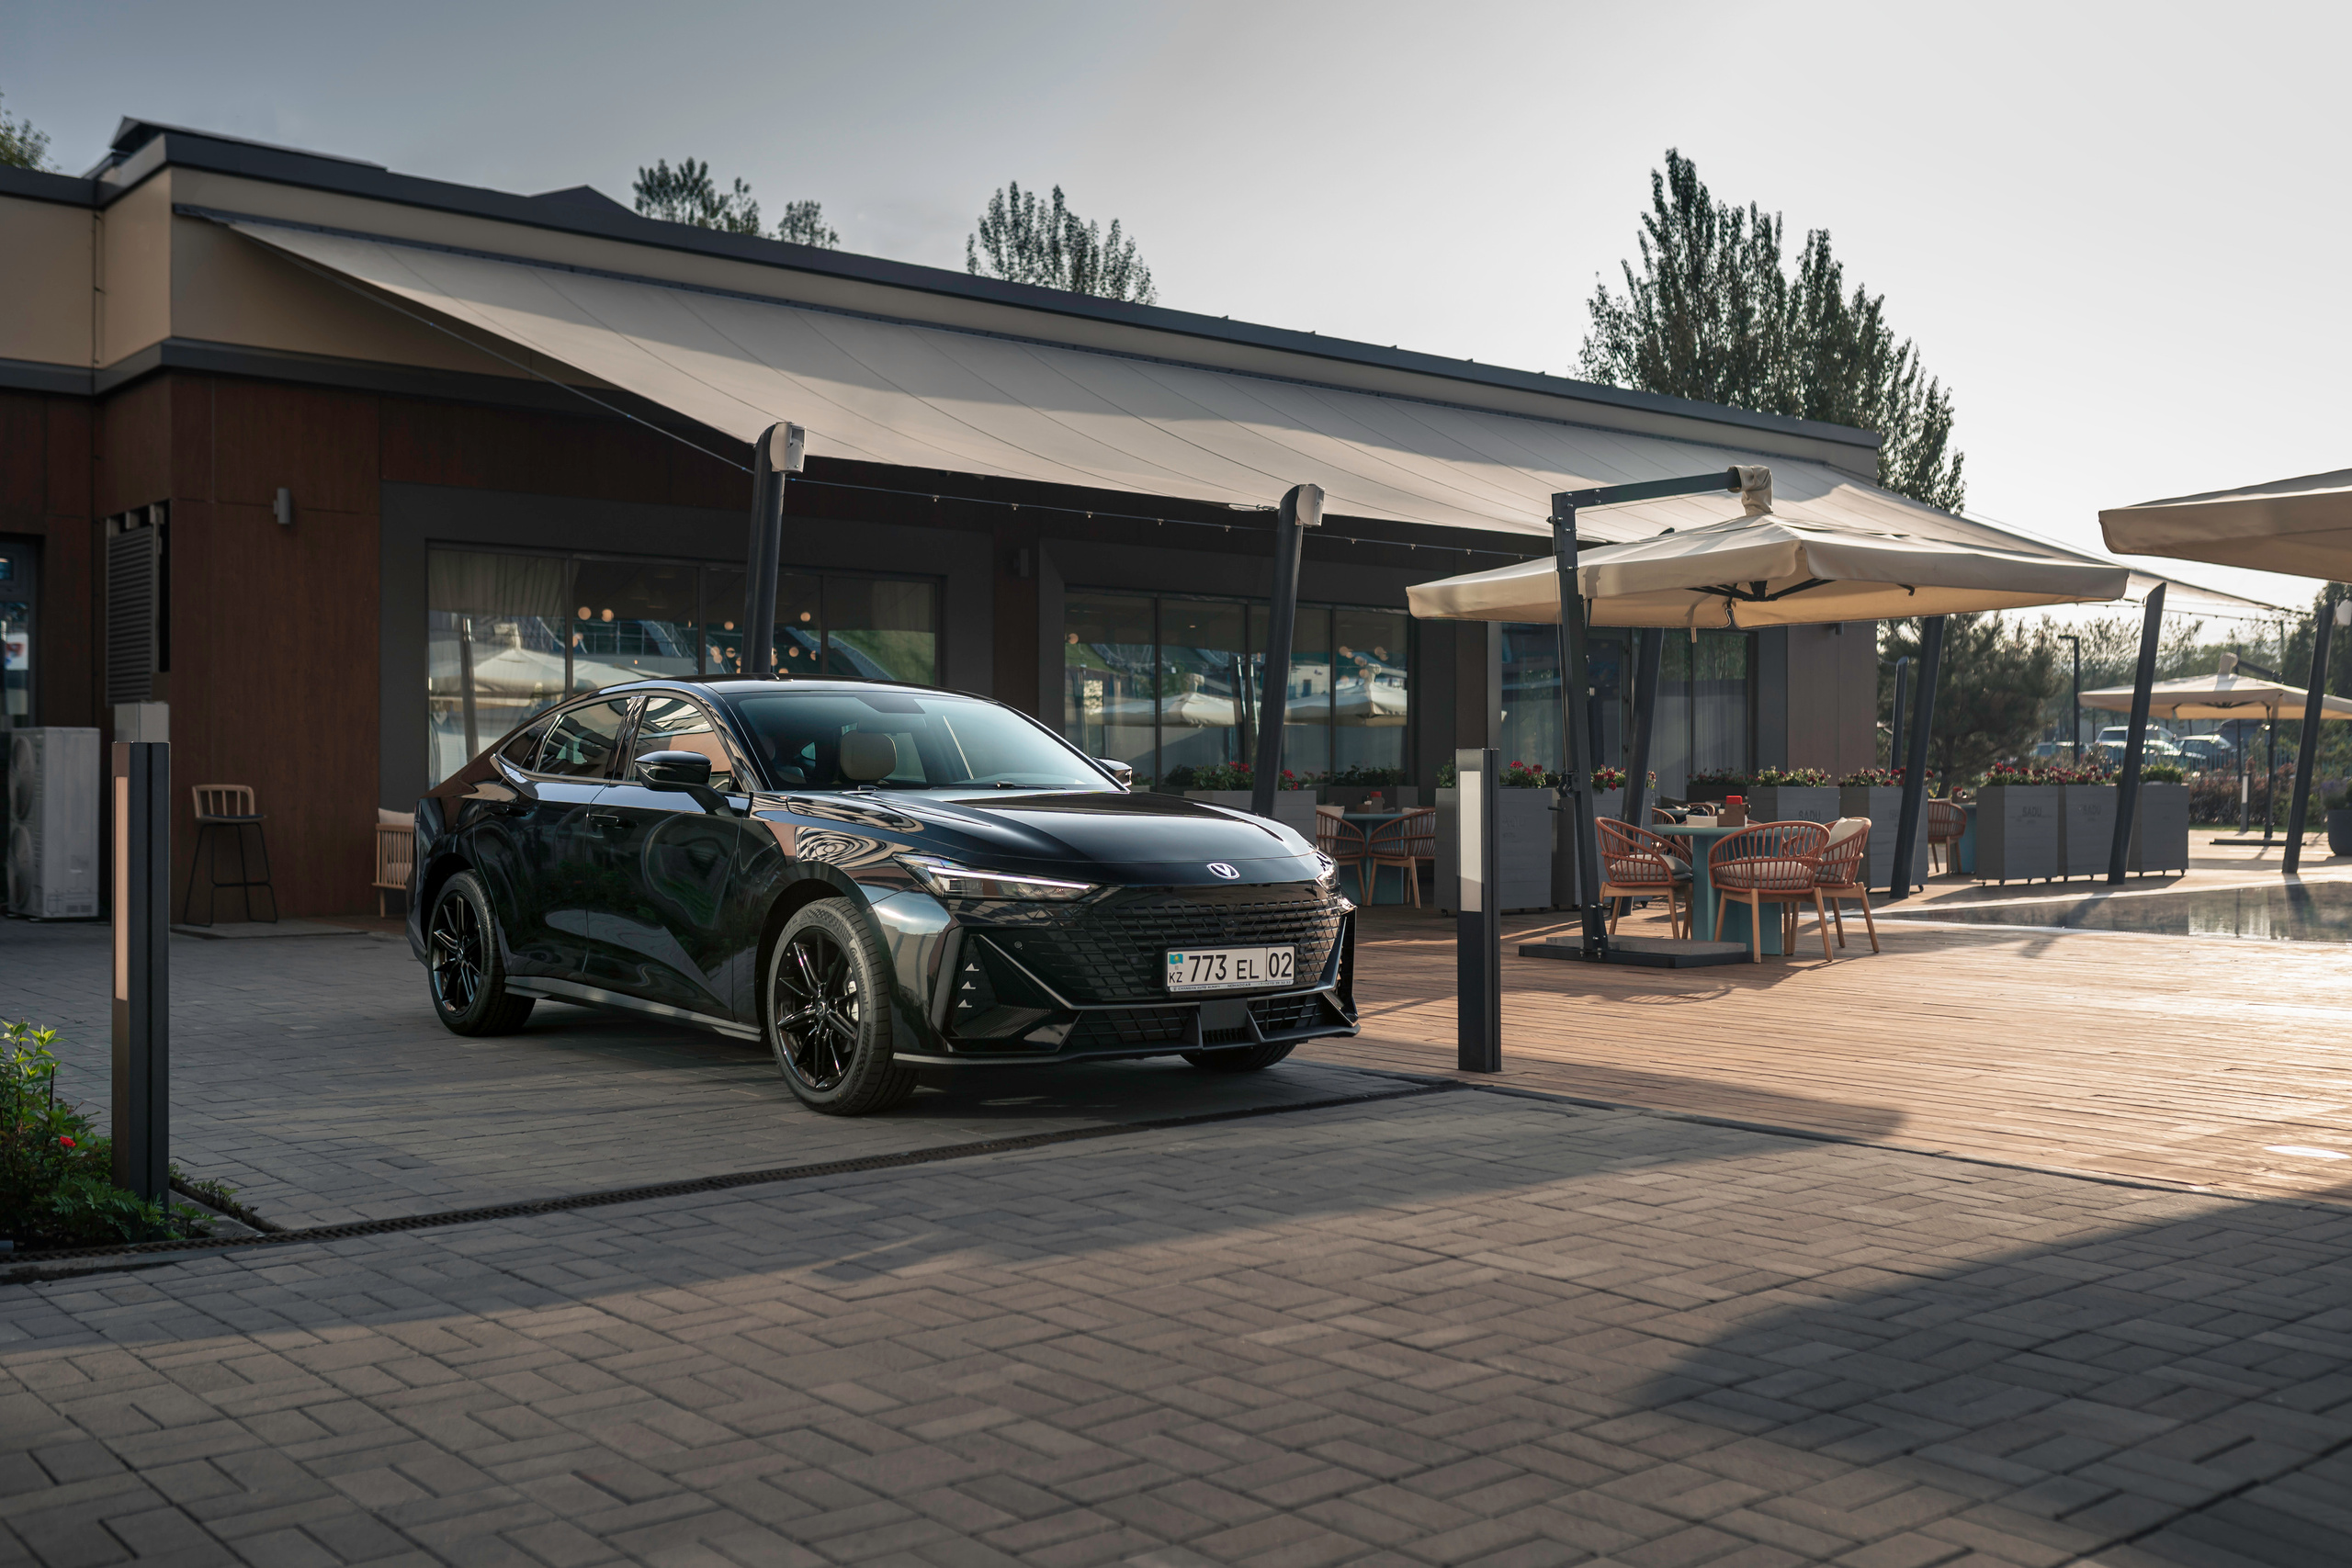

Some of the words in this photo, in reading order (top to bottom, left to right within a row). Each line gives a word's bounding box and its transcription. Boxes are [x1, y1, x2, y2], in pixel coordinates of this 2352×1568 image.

[1798, 809, 1821, 821] SADU
[2022, 806, 2042, 818] SADU
[1189, 954, 1227, 982] 773
[1237, 959, 1260, 979] EL
[1269, 952, 1292, 978] 02
[849, 947, 869, 1004] Continental
[1169, 972, 1183, 983] KZ
